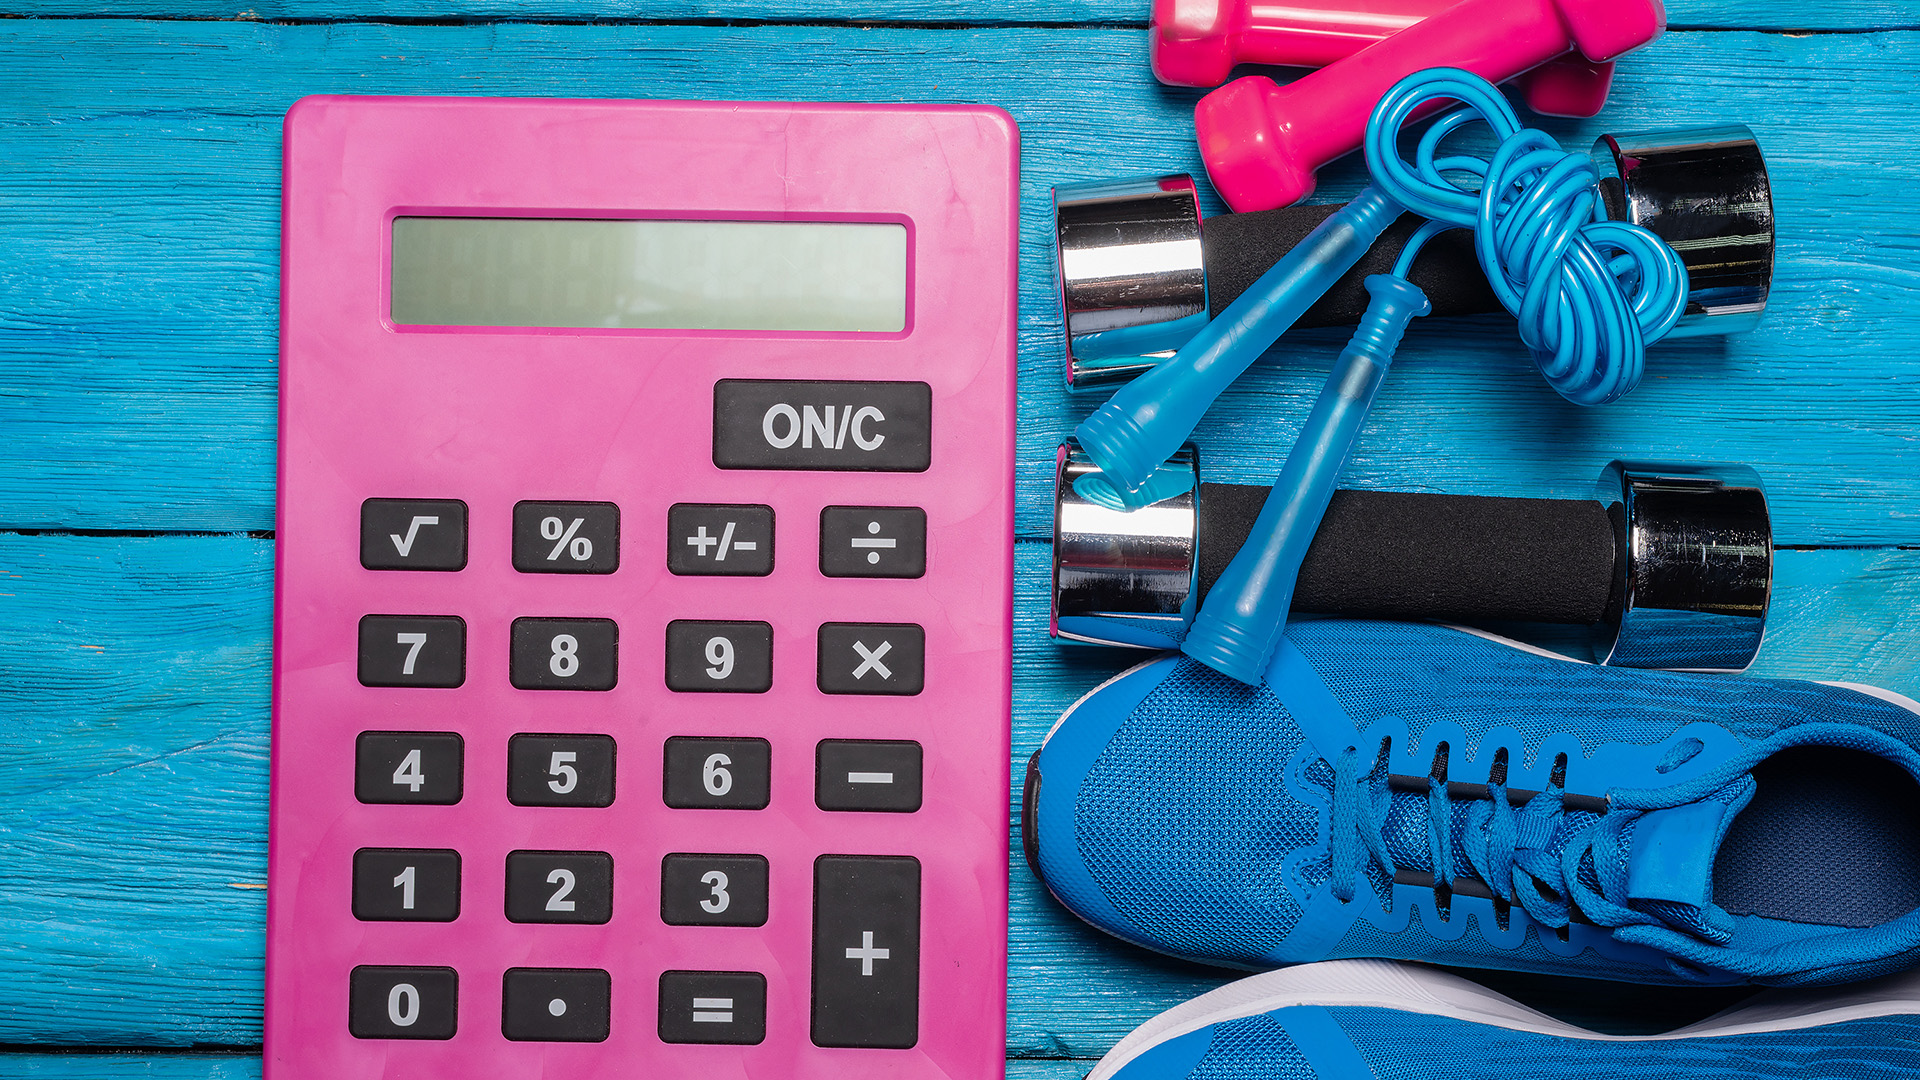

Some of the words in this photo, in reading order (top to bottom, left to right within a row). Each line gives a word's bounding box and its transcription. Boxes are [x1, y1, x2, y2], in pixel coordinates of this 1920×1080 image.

[763, 403, 885, 451] ON/C
[541, 517, 592, 560] %
[397, 633, 426, 674] 7
[550, 634, 579, 677] 8
[705, 637, 734, 679] 9
[393, 750, 424, 791] 4
[548, 752, 577, 793] 5
[703, 753, 732, 796] 6
[394, 867, 415, 909] 1
[545, 869, 575, 911] 2
[700, 871, 729, 913] 3
[388, 984, 419, 1026] 0
